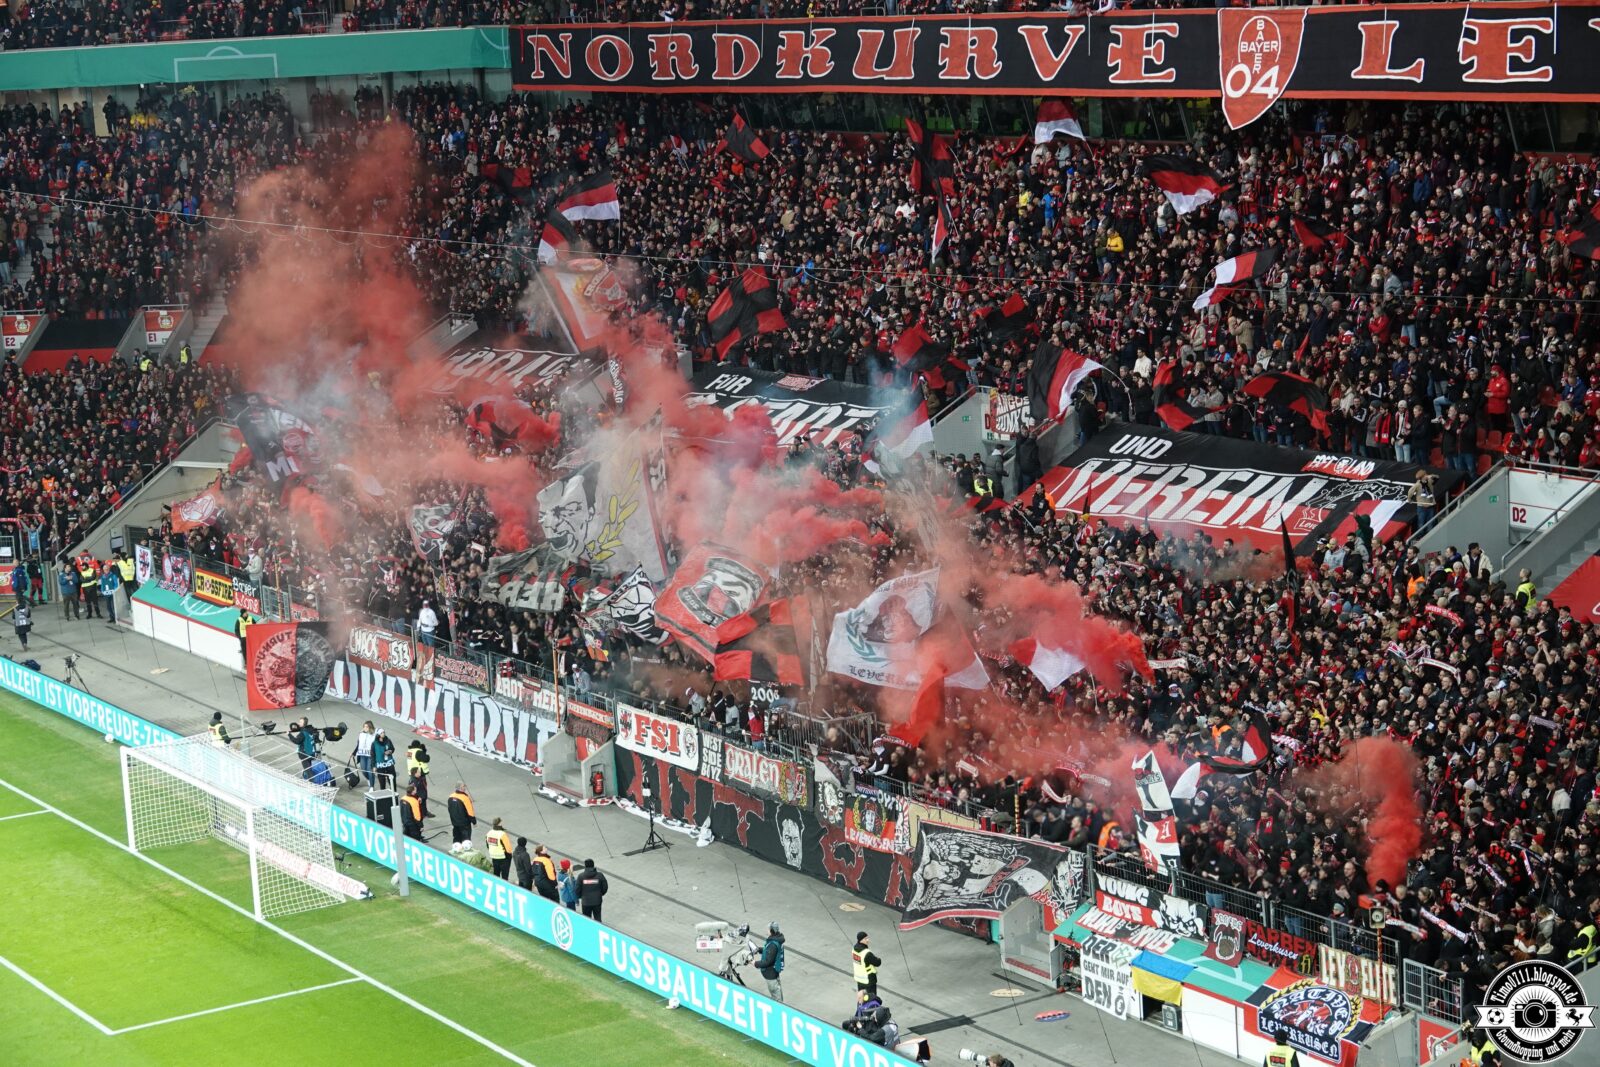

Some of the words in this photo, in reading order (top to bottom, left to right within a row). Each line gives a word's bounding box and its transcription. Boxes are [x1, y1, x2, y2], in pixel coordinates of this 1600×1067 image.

[527, 22, 1180, 83] NORDKURVE
[1240, 40, 1279, 53] BAYER
[1225, 63, 1280, 99] 04
[5, 337, 16, 347] E2
[704, 373, 753, 394] FÜR
[1109, 433, 1173, 460] UND
[1055, 460, 1330, 530] VEREIN
[1512, 506, 1527, 523] D2
[43, 679, 64, 709] IST
[633, 713, 682, 757] FSI
[702, 747, 723, 768] SIDE
[333, 809, 359, 847] IST
[1096, 871, 1150, 907] YOUNG
[1082, 934, 1118, 965] DER
[1083, 959, 1100, 976] GEHT
[1100, 963, 1115, 981] MIR
[1320, 945, 1346, 989] LEV
[598, 929, 773, 1039] FUSSBALLZEIT
[781, 1011, 822, 1061] IST
[1084, 975, 1112, 1010] DEN
